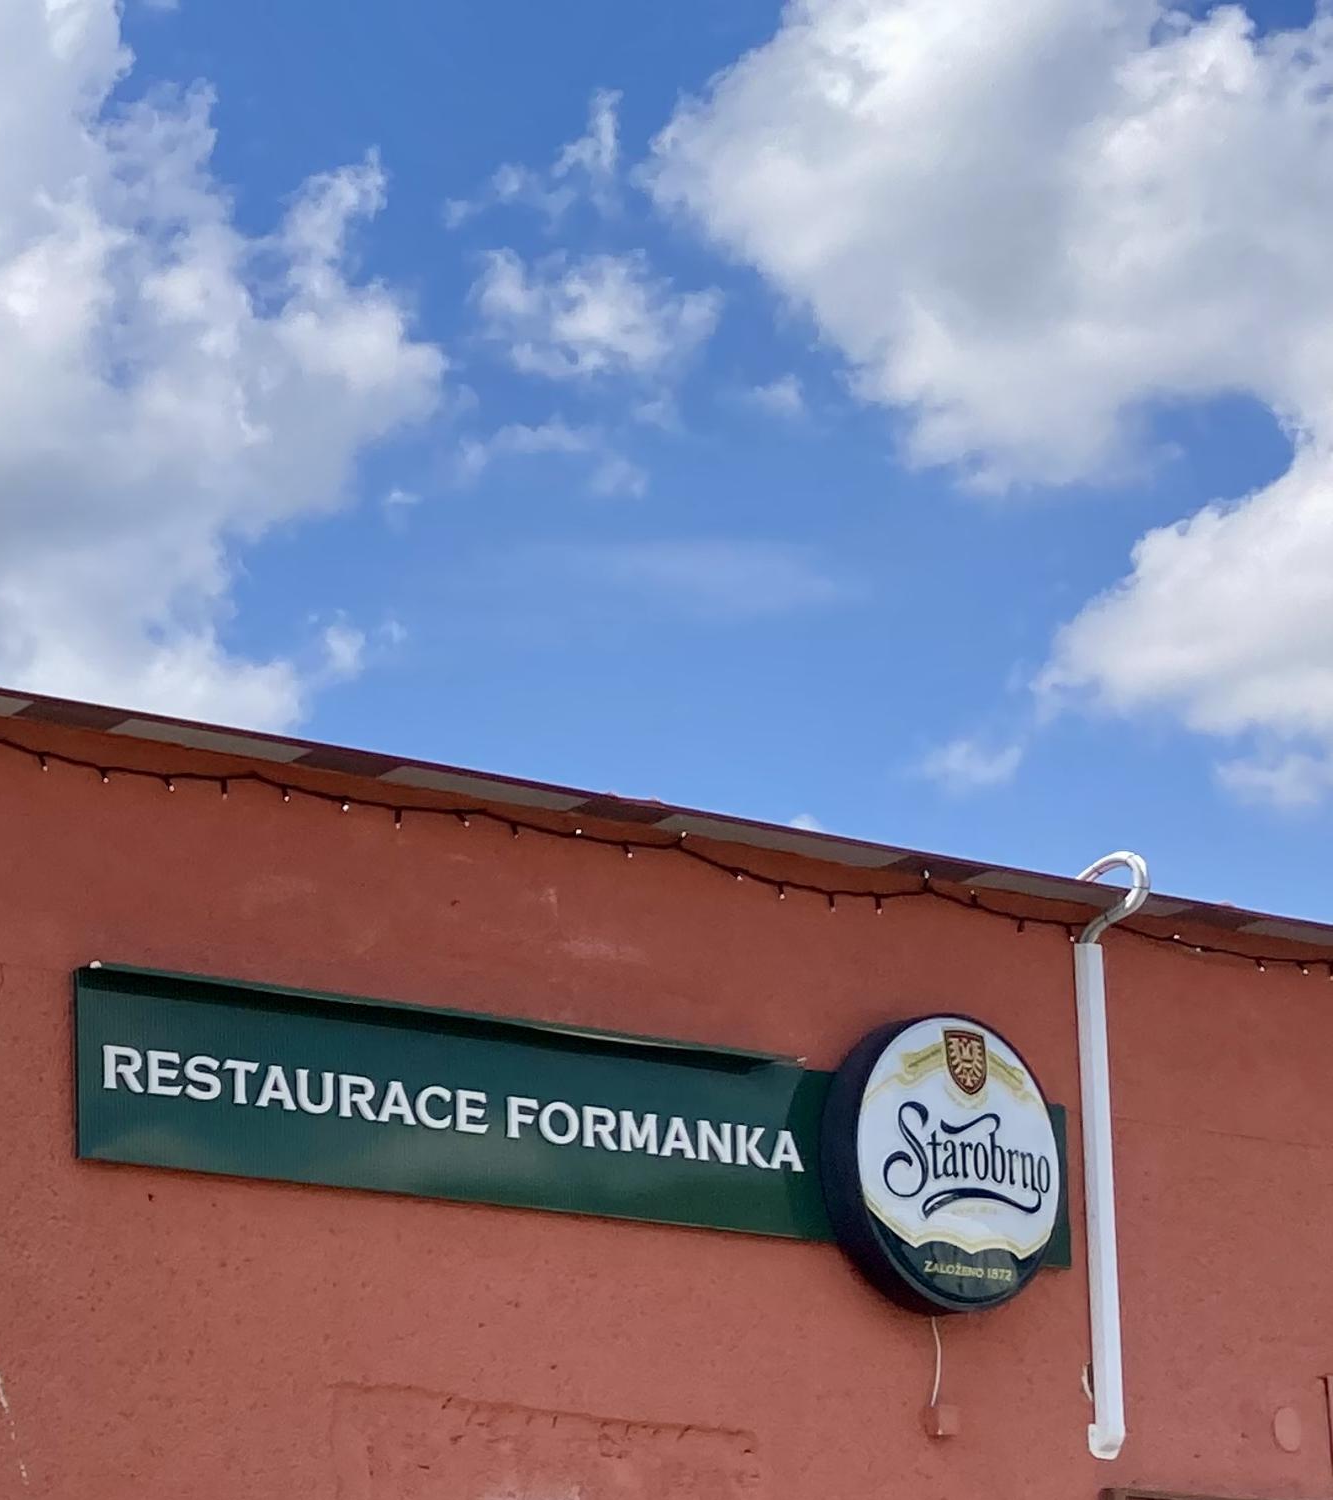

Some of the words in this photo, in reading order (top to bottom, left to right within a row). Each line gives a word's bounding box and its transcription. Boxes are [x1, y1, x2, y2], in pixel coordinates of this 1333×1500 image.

[101, 1043, 488, 1135] RESTAURACE
[504, 1096, 805, 1174] FORMANKA
[883, 1101, 1051, 1214] Starobrno
[987, 1267, 1014, 1282] 1872
